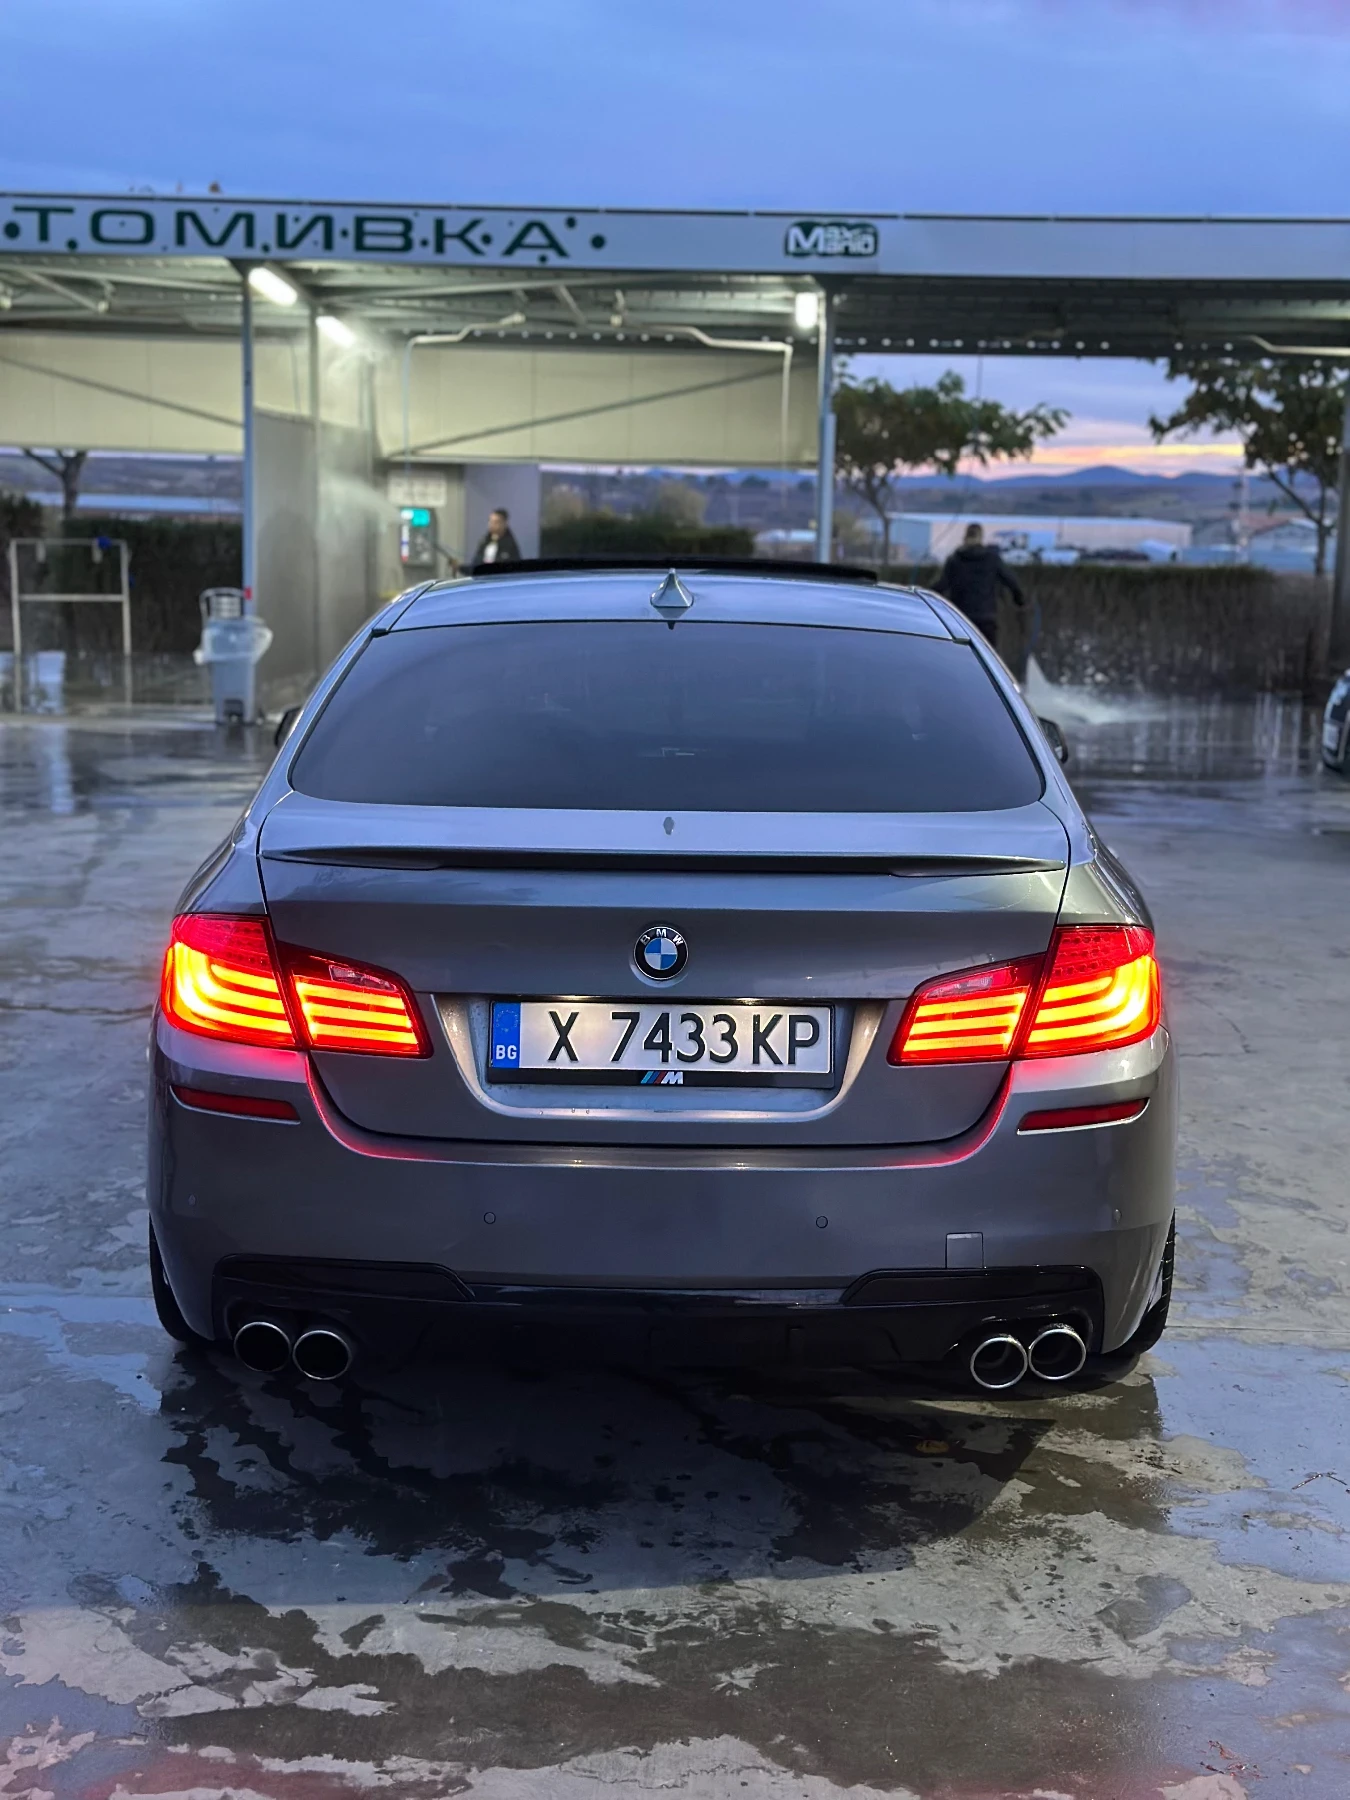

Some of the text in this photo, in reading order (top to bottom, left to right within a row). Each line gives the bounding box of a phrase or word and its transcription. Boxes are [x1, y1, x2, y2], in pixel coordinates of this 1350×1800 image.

[640, 928, 684, 946] BMW
[547, 1010, 820, 1066] X 7433 KP
[495, 1045, 517, 1060] BG
